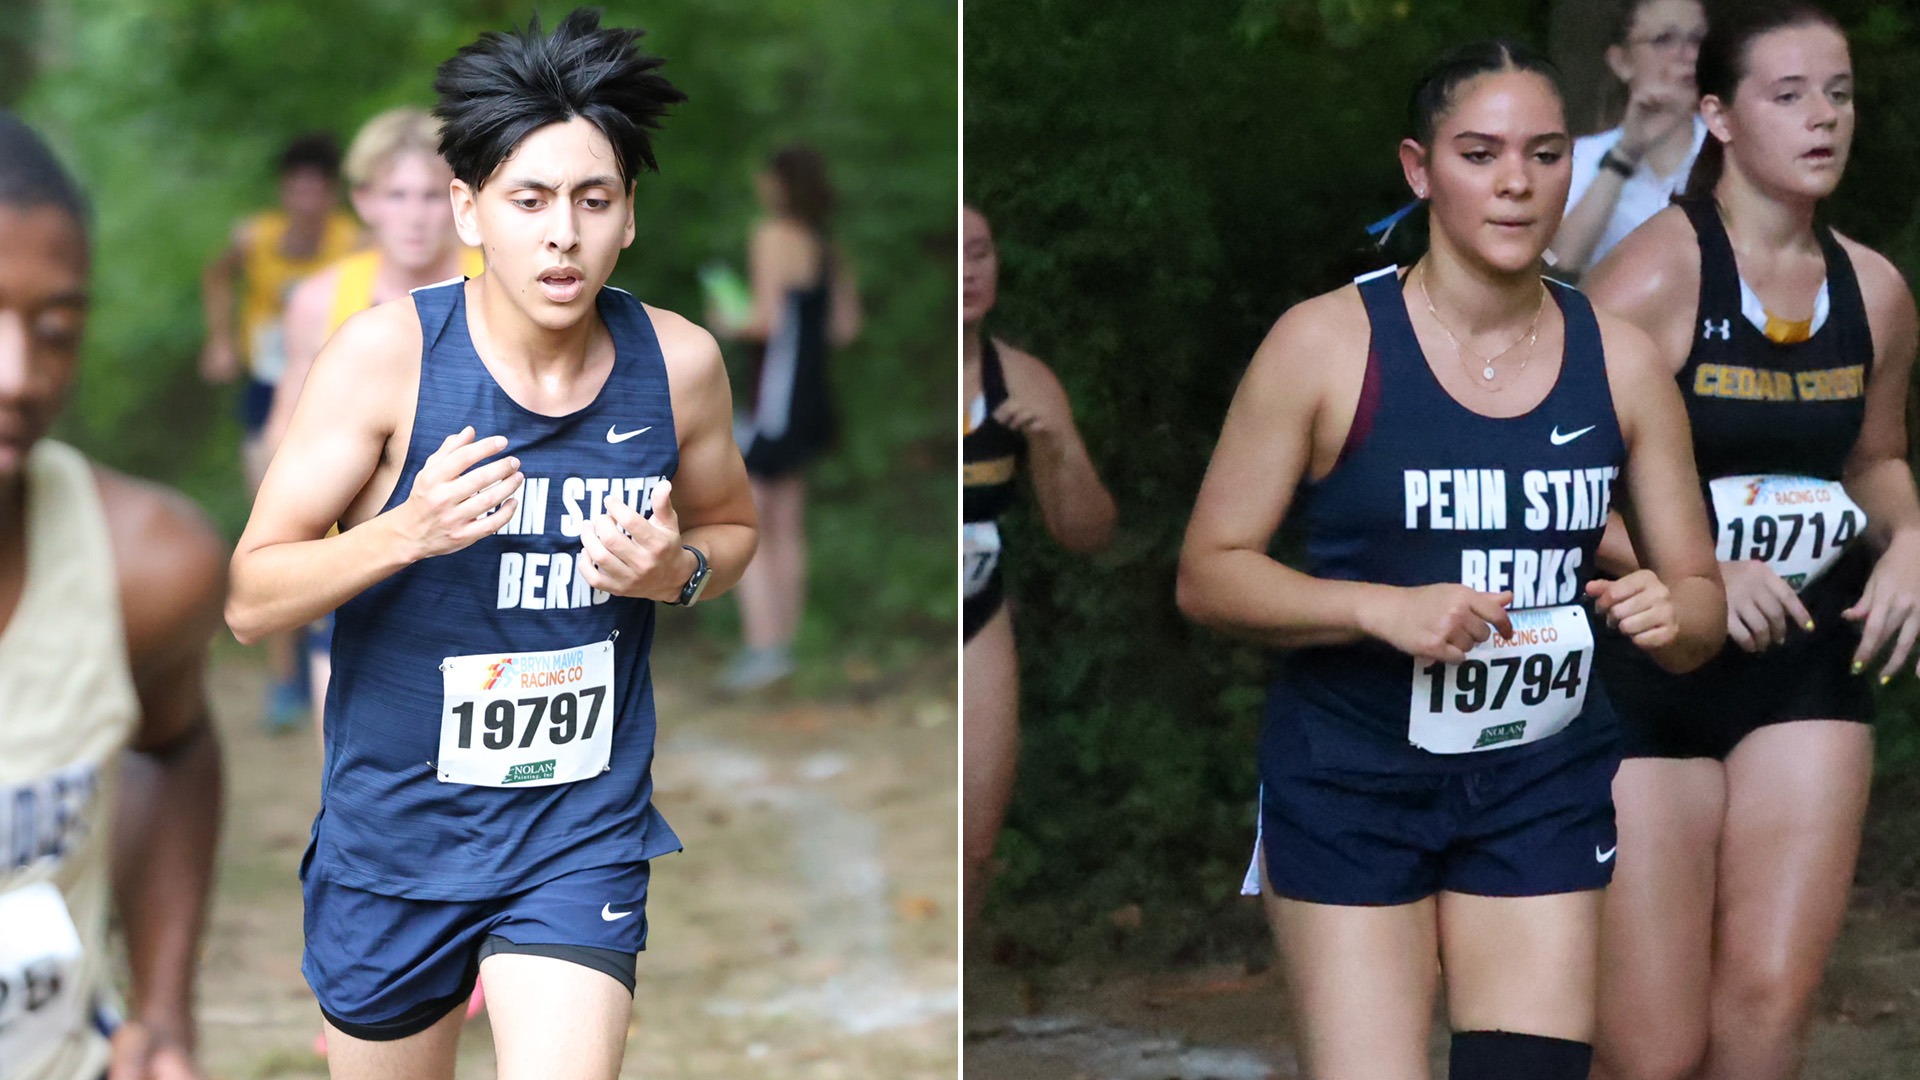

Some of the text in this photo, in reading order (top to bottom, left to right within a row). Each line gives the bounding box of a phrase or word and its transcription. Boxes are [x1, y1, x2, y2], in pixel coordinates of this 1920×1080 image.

[1693, 363, 1796, 401] CEDAR
[476, 478, 550, 535] NN
[1403, 466, 1614, 531] PENN STATE
[1815, 489, 1831, 502] CO
[1727, 510, 1857, 562] 19714
[1461, 547, 1582, 609] BERKS
[1541, 627, 1558, 643] CO
[520, 650, 584, 672] BRYN MAWR
[521, 665, 583, 688] RACING CO
[1423, 650, 1583, 714] 19794
[452, 685, 606, 750] 19797
[514, 763, 553, 774] NOLAN
